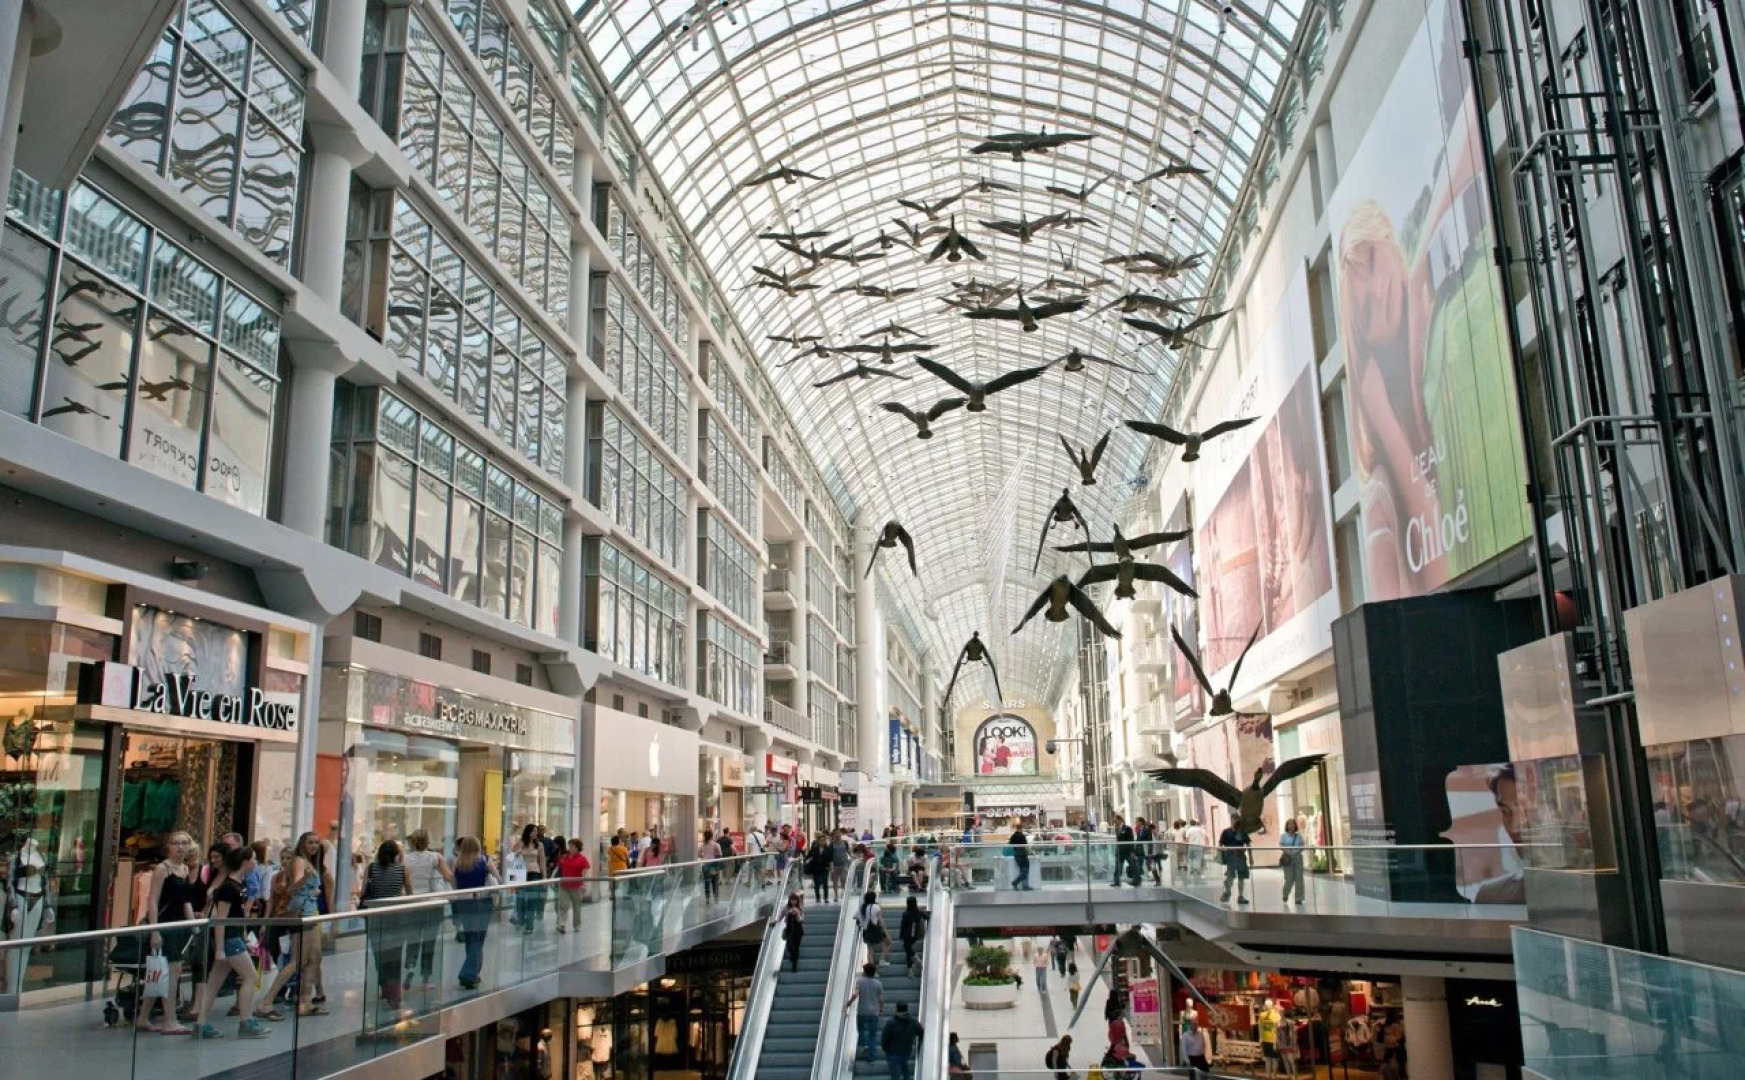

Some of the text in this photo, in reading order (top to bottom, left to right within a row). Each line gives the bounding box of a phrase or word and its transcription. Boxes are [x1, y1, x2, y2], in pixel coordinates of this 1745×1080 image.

[1411, 436, 1446, 483] L'EAU
[1406, 488, 1469, 573] Chloé
[133, 666, 298, 732] La Vie en Rose
[983, 726, 1026, 739] LOOK!
